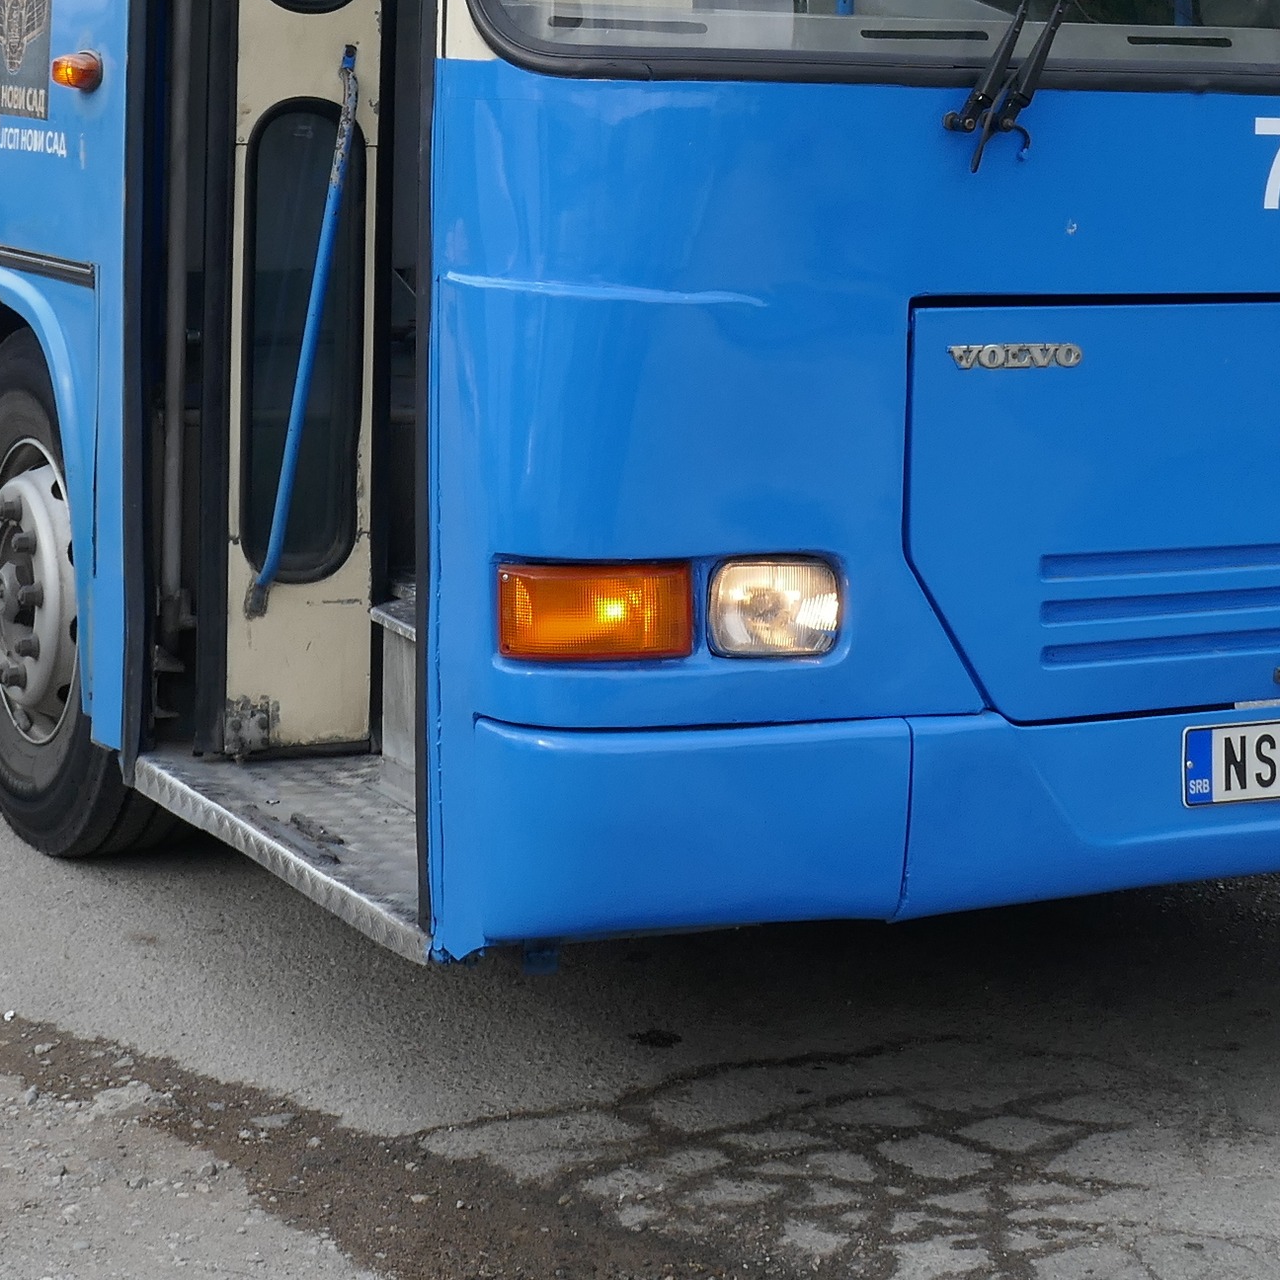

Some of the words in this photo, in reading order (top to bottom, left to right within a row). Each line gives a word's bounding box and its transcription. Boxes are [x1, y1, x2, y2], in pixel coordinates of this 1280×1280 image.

[1, 84, 26, 110] НОВИ
[26, 86, 46, 118] САД
[20, 128, 45, 153] НОВИ
[45, 130, 67, 158] САД
[946, 343, 1083, 370] VOLVO
[1223, 733, 1277, 792] NS
[1188, 778, 1211, 795] SRB
